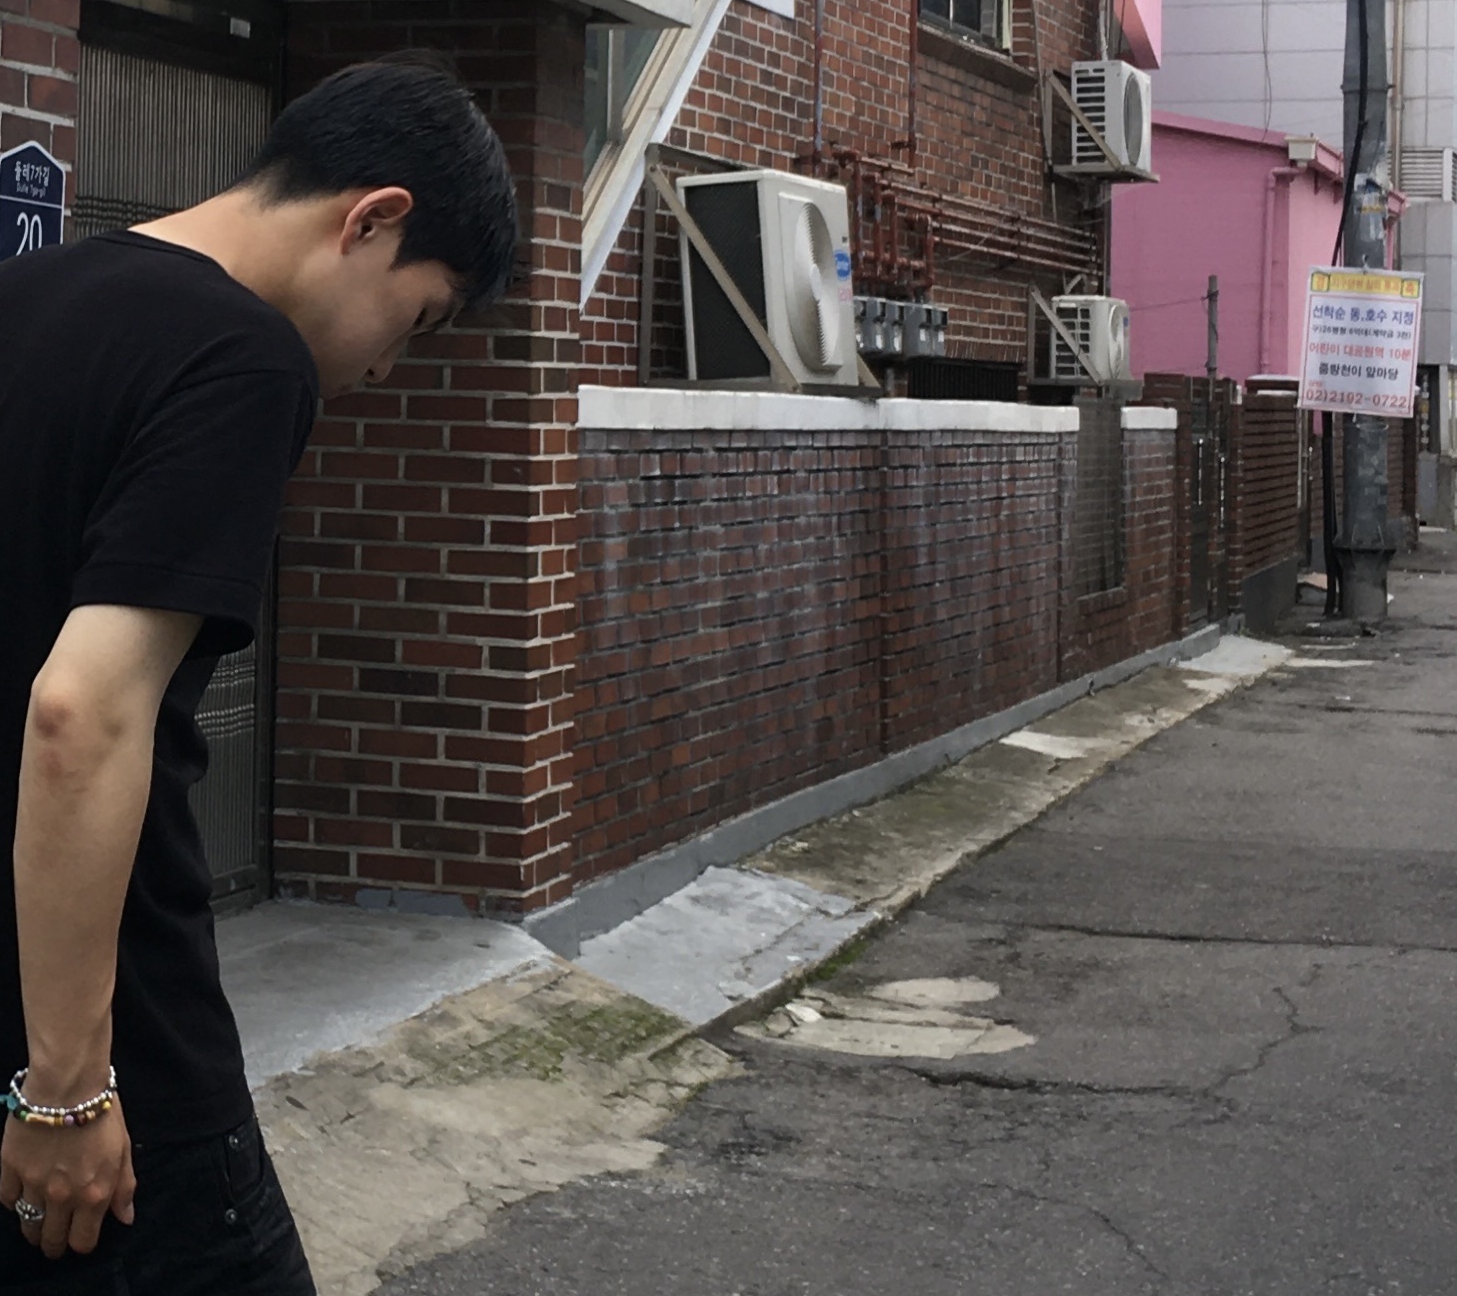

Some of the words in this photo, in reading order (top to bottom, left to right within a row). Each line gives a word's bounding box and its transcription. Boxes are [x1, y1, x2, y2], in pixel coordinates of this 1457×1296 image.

[16, 211, 43, 256] 20
[1313, 305, 1346, 321] 선착순
[1392, 310, 1414, 326] 지정
[1309, 342, 1340, 356] 어린이
[1389, 348, 1411, 362] 10분
[1318, 362, 1362, 378] 중랑천이
[1365, 364, 1399, 380] 앞마당
